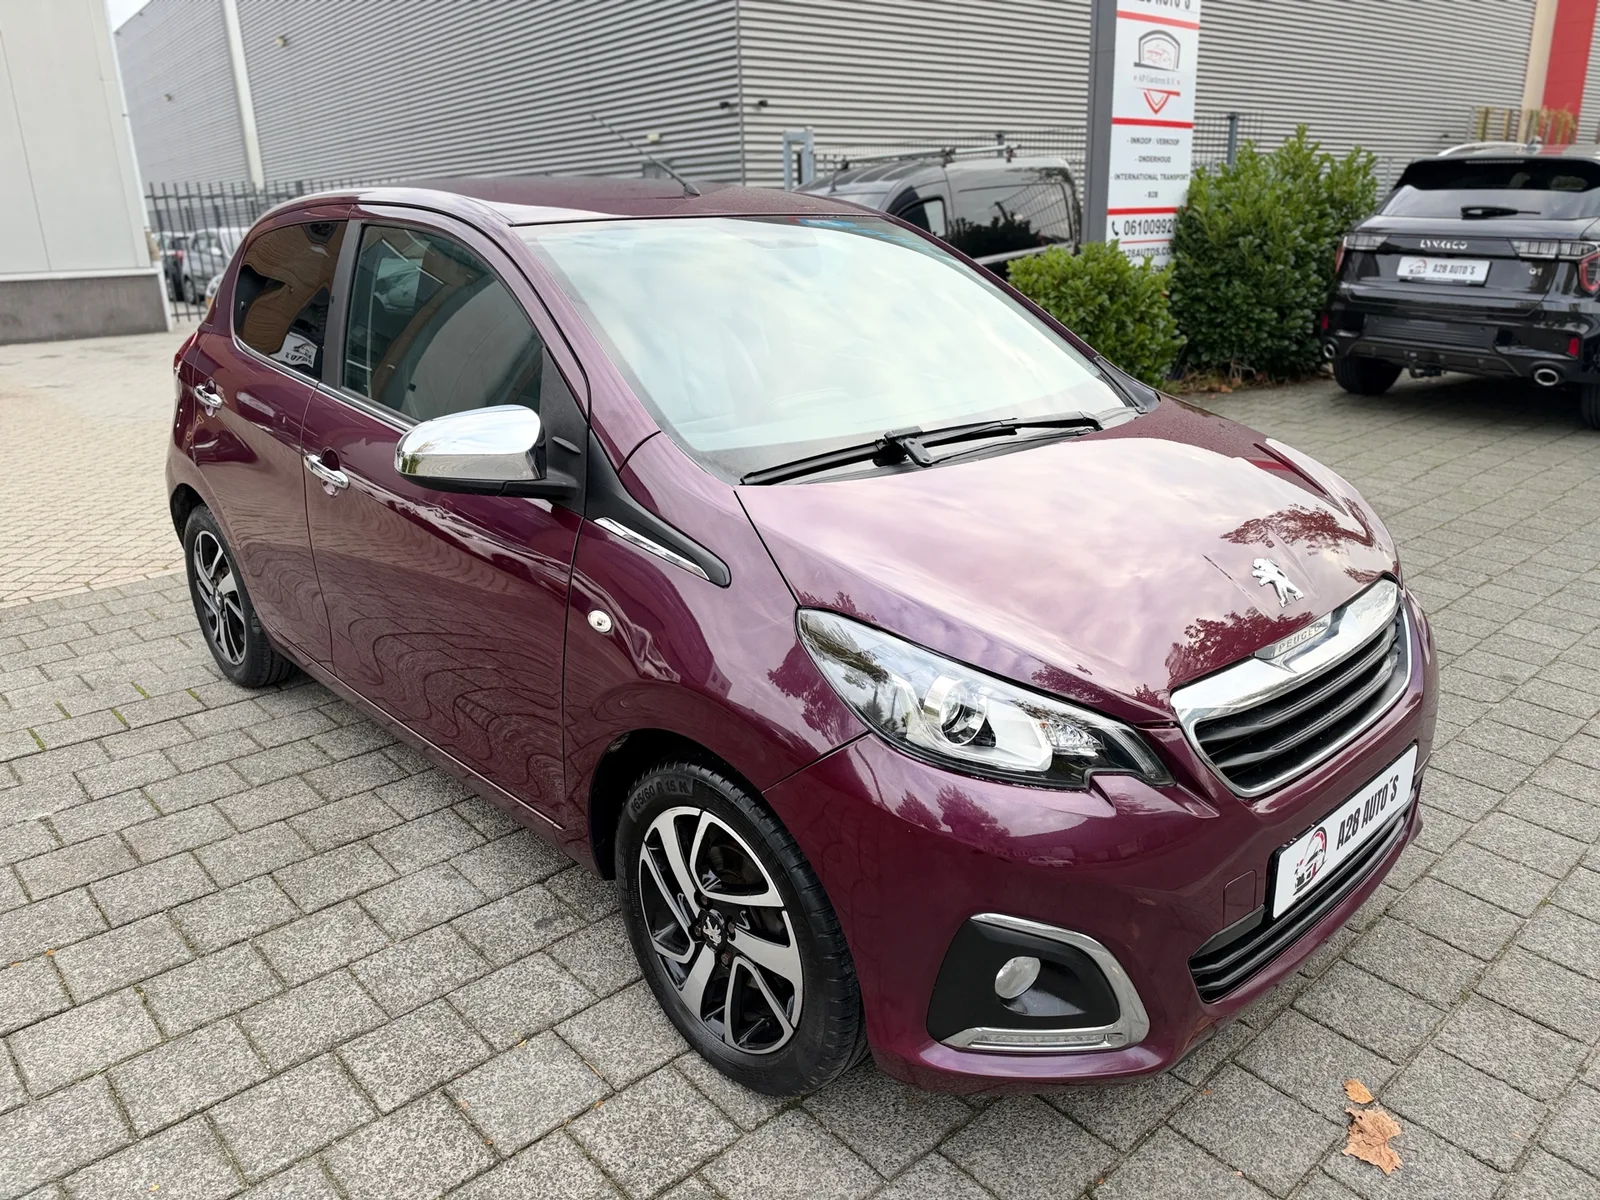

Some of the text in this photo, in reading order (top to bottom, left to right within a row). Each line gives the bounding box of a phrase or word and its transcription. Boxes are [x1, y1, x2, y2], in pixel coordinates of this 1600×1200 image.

[1130, 136, 1180, 146] INKOOP VERKOOP
[1138, 155, 1172, 163] ONDERHOUD
[1114, 173, 1189, 181] INTERNATIONAL TRANSPORT
[1336, 807, 1361, 851] A28
